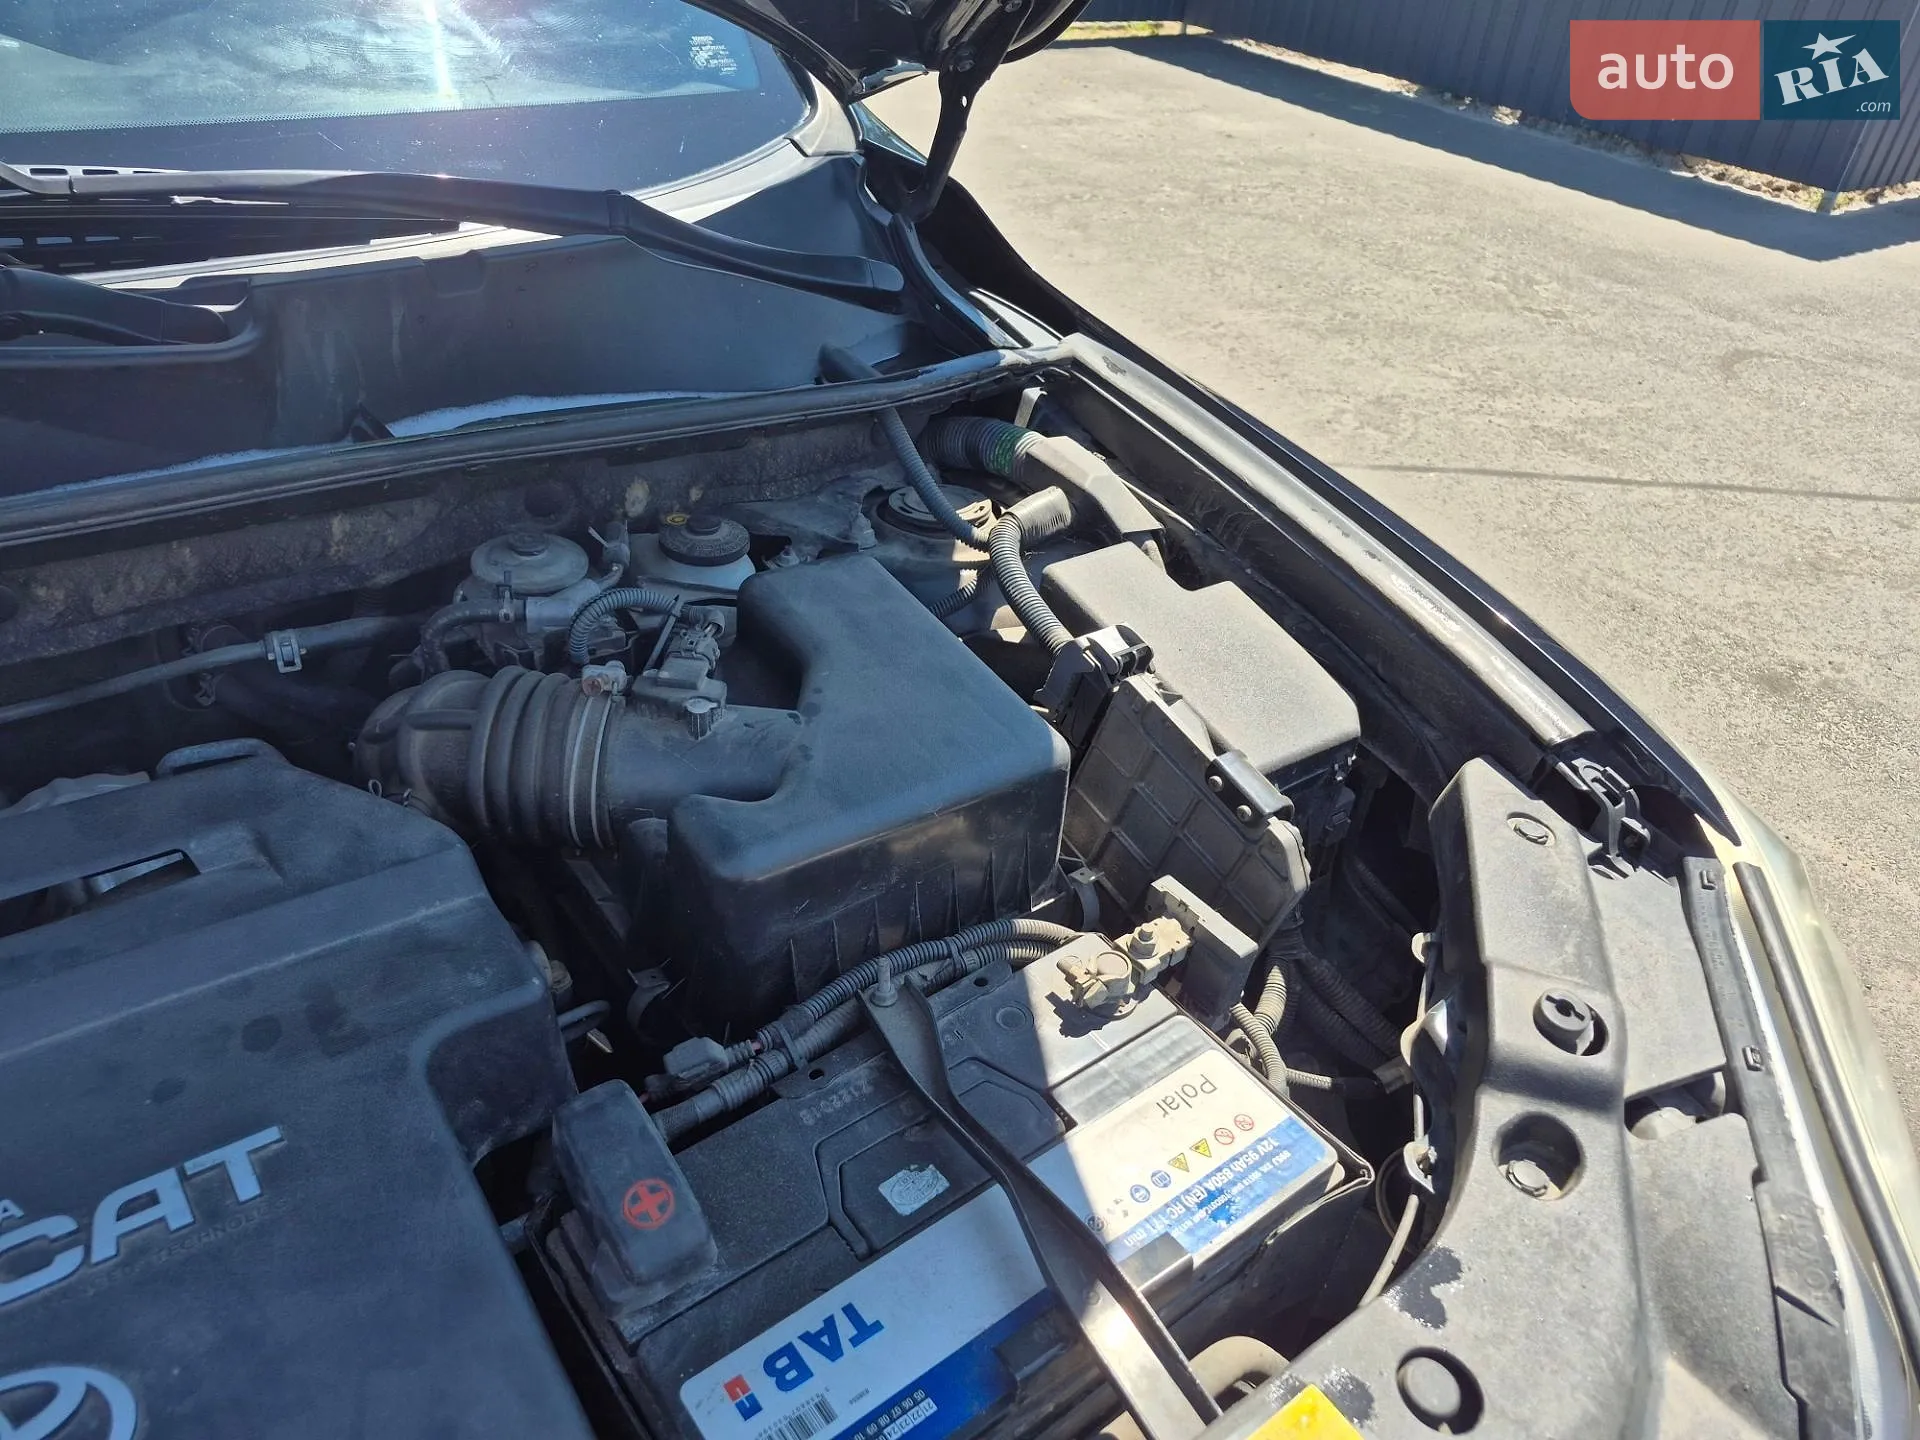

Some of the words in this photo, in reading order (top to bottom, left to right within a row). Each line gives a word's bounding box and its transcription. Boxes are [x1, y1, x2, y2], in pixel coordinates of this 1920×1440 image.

[1155, 1073, 1217, 1118] Polar
[1254, 1136, 1279, 1155] 12V
[1229, 1149, 1260, 1174] 95Ah
[1202, 1167, 1233, 1191] 850A
[1179, 1184, 1207, 1208] (EN)
[1165, 1201, 1184, 1219] RC
[1123, 1228, 1148, 1248] min
[763, 1302, 884, 1391] TAB
[912, 1389, 925, 1401] 05
